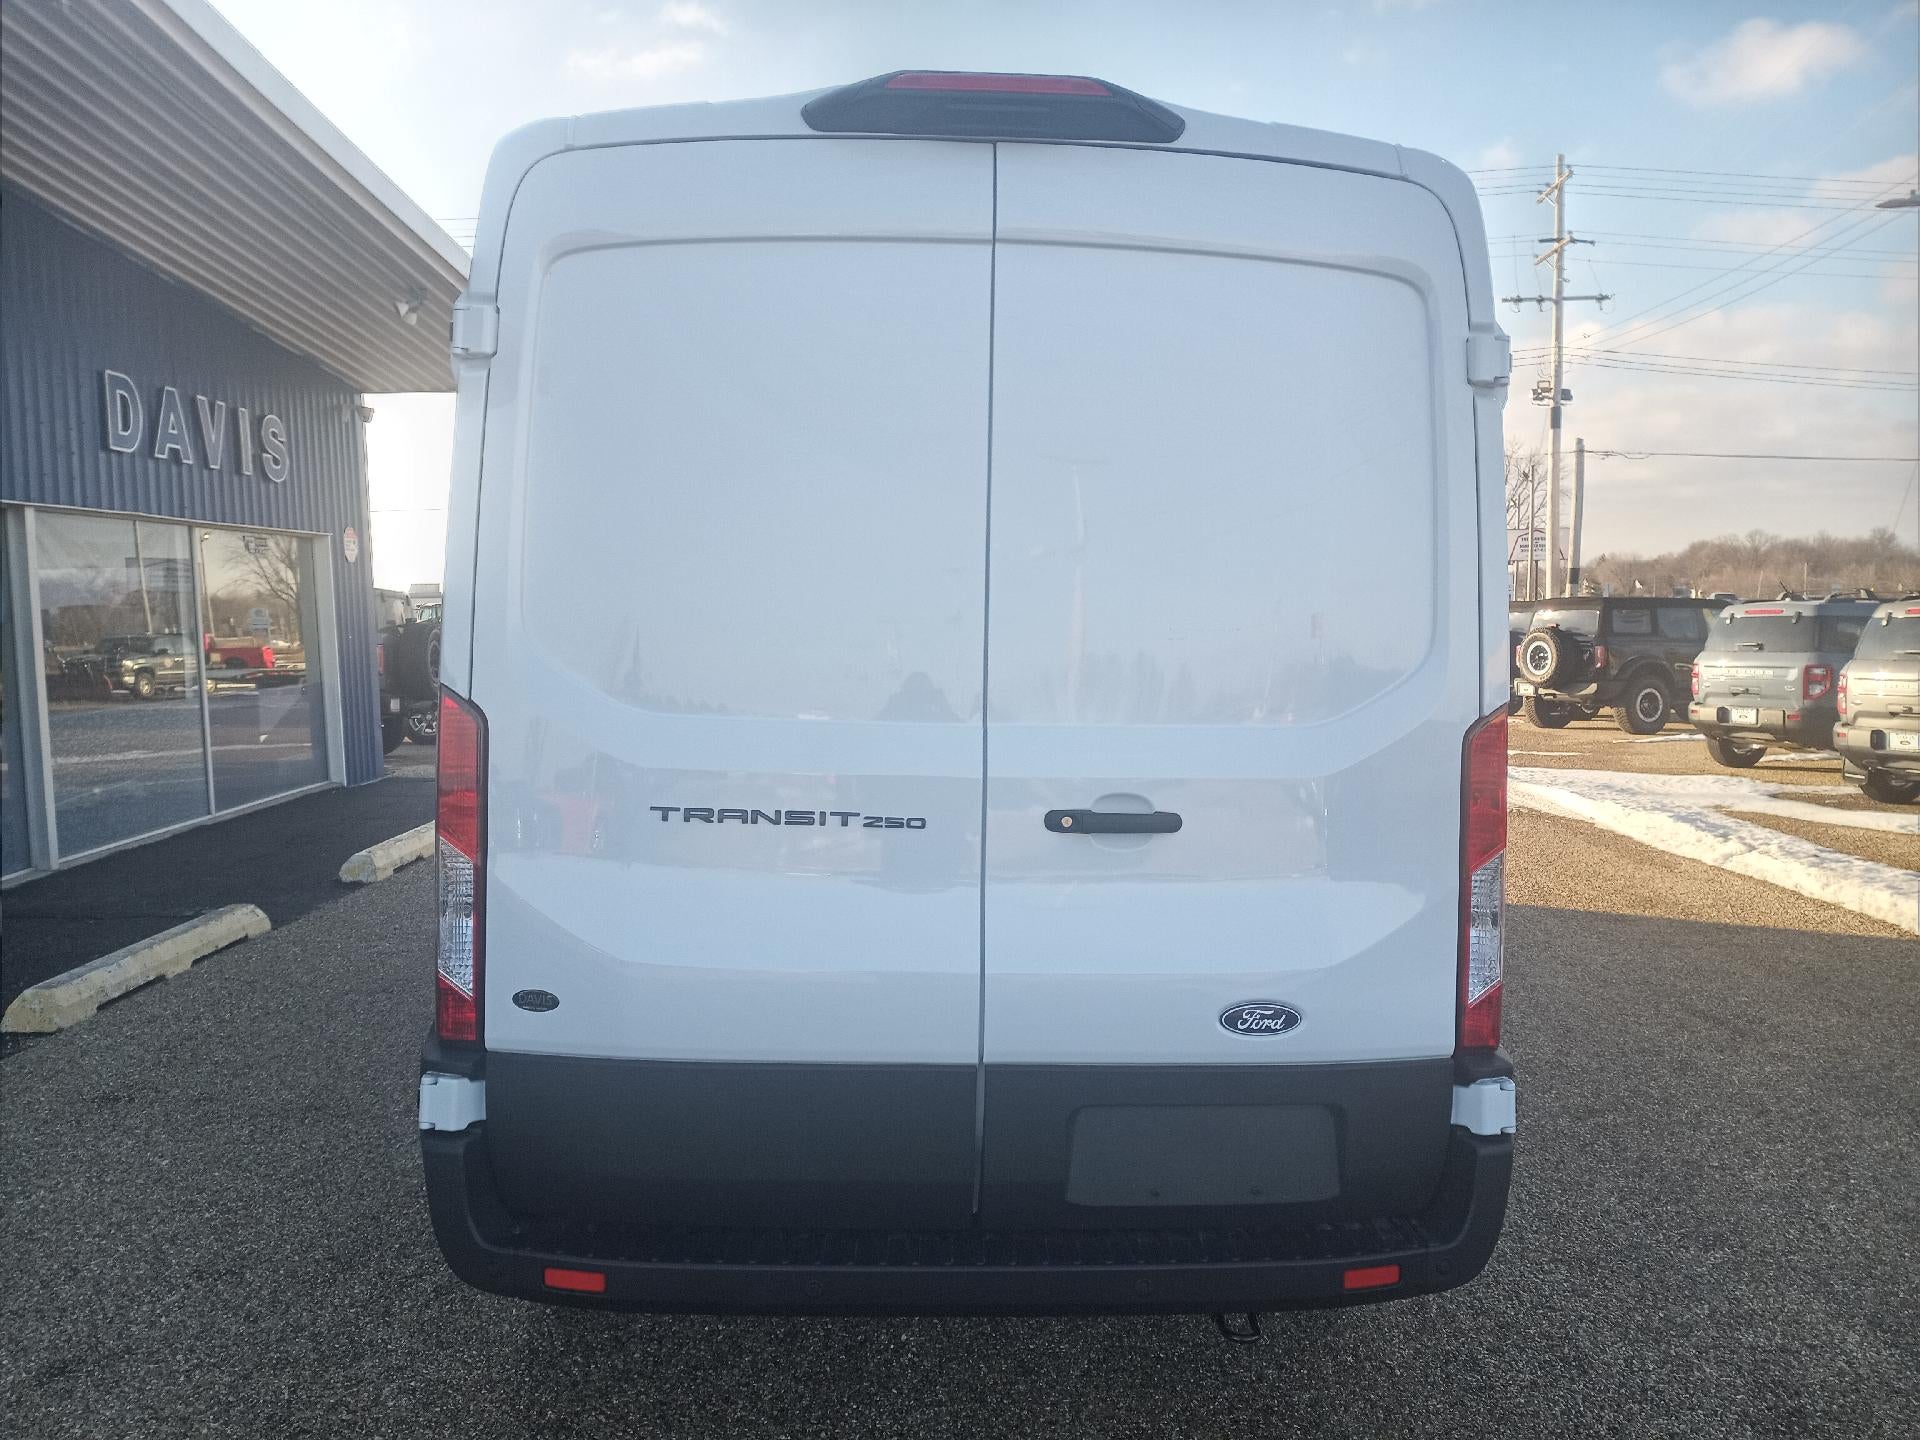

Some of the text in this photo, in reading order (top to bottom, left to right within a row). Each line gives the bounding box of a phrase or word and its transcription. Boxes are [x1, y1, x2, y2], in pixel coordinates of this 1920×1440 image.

[104, 369, 289, 482] DAVIS
[649, 806, 927, 830] TRANSIT 250
[518, 992, 553, 1006] DAVIS
[1237, 1009, 1286, 1030] Ford
